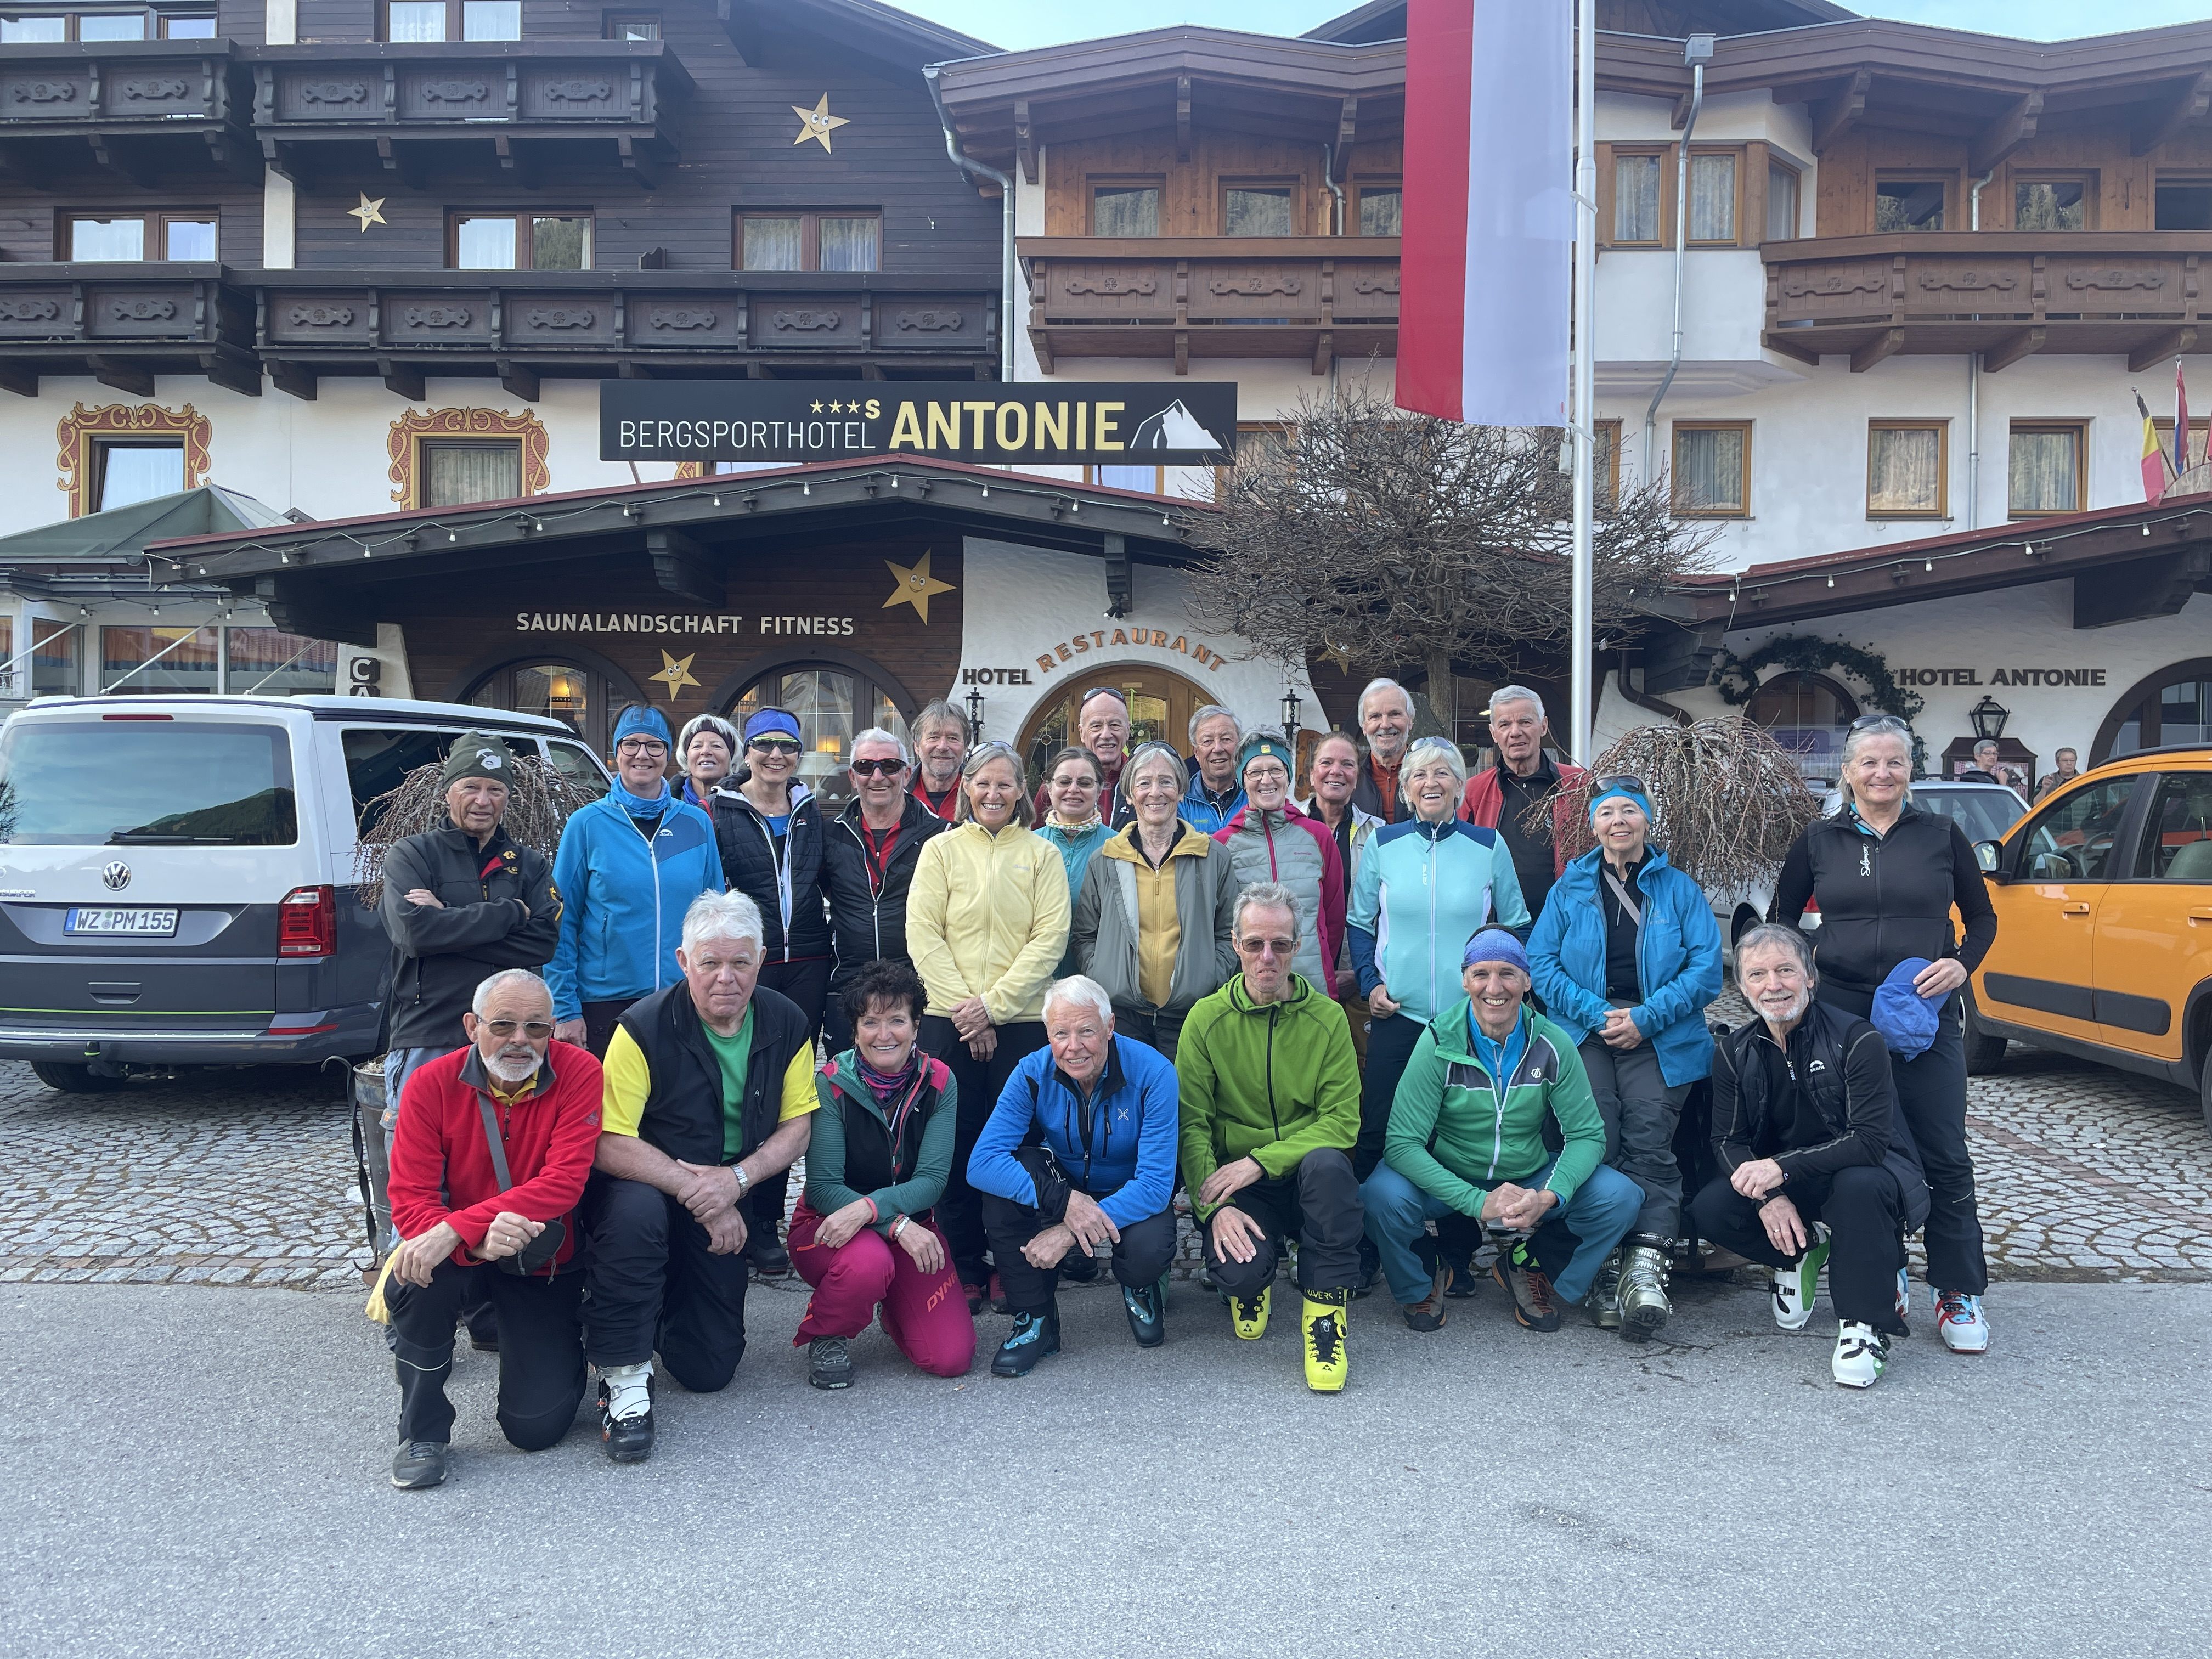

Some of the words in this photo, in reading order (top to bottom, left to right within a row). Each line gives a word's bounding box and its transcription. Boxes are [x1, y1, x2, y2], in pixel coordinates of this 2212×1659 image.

[620, 420, 876, 449] BERGSPORTHOTEL
[889, 401, 1125, 451] ANTONIE
[516, 612, 742, 634] SAUNALANDSCHAFT
[760, 616, 854, 635] FITNESS
[1035, 627, 1227, 673] RESTAURANT
[962, 668, 1032, 685] HOTEL
[1900, 669, 1982, 686] HOTEL
[1990, 669, 2106, 686] ANTONIE
[1859, 843, 1871, 876] Salomon
[77, 911, 101, 929] WZ
[111, 911, 138, 929] PM
[138, 912, 175, 930] 155
